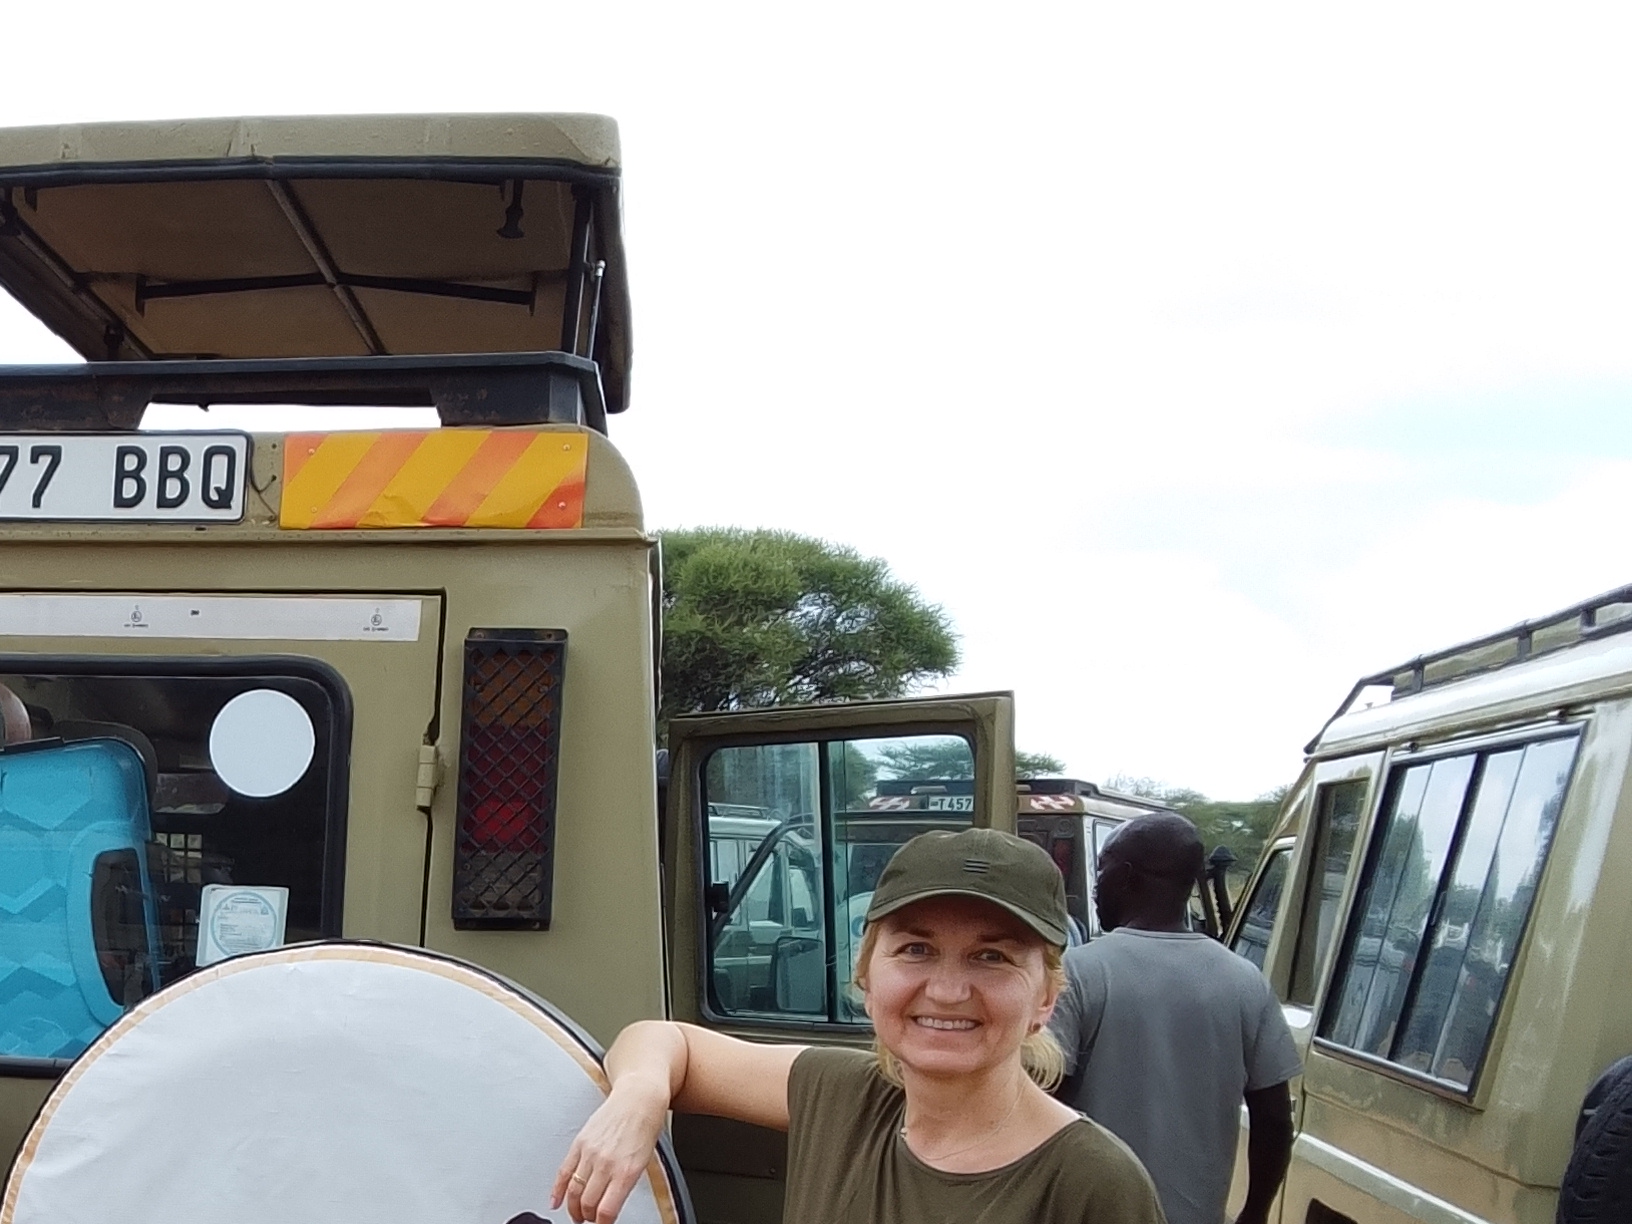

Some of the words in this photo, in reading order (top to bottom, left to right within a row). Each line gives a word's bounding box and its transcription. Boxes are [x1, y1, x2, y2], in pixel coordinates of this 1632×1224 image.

[112, 444, 238, 510] BBQ
[939, 797, 948, 811] T
[949, 797, 972, 811] 457
